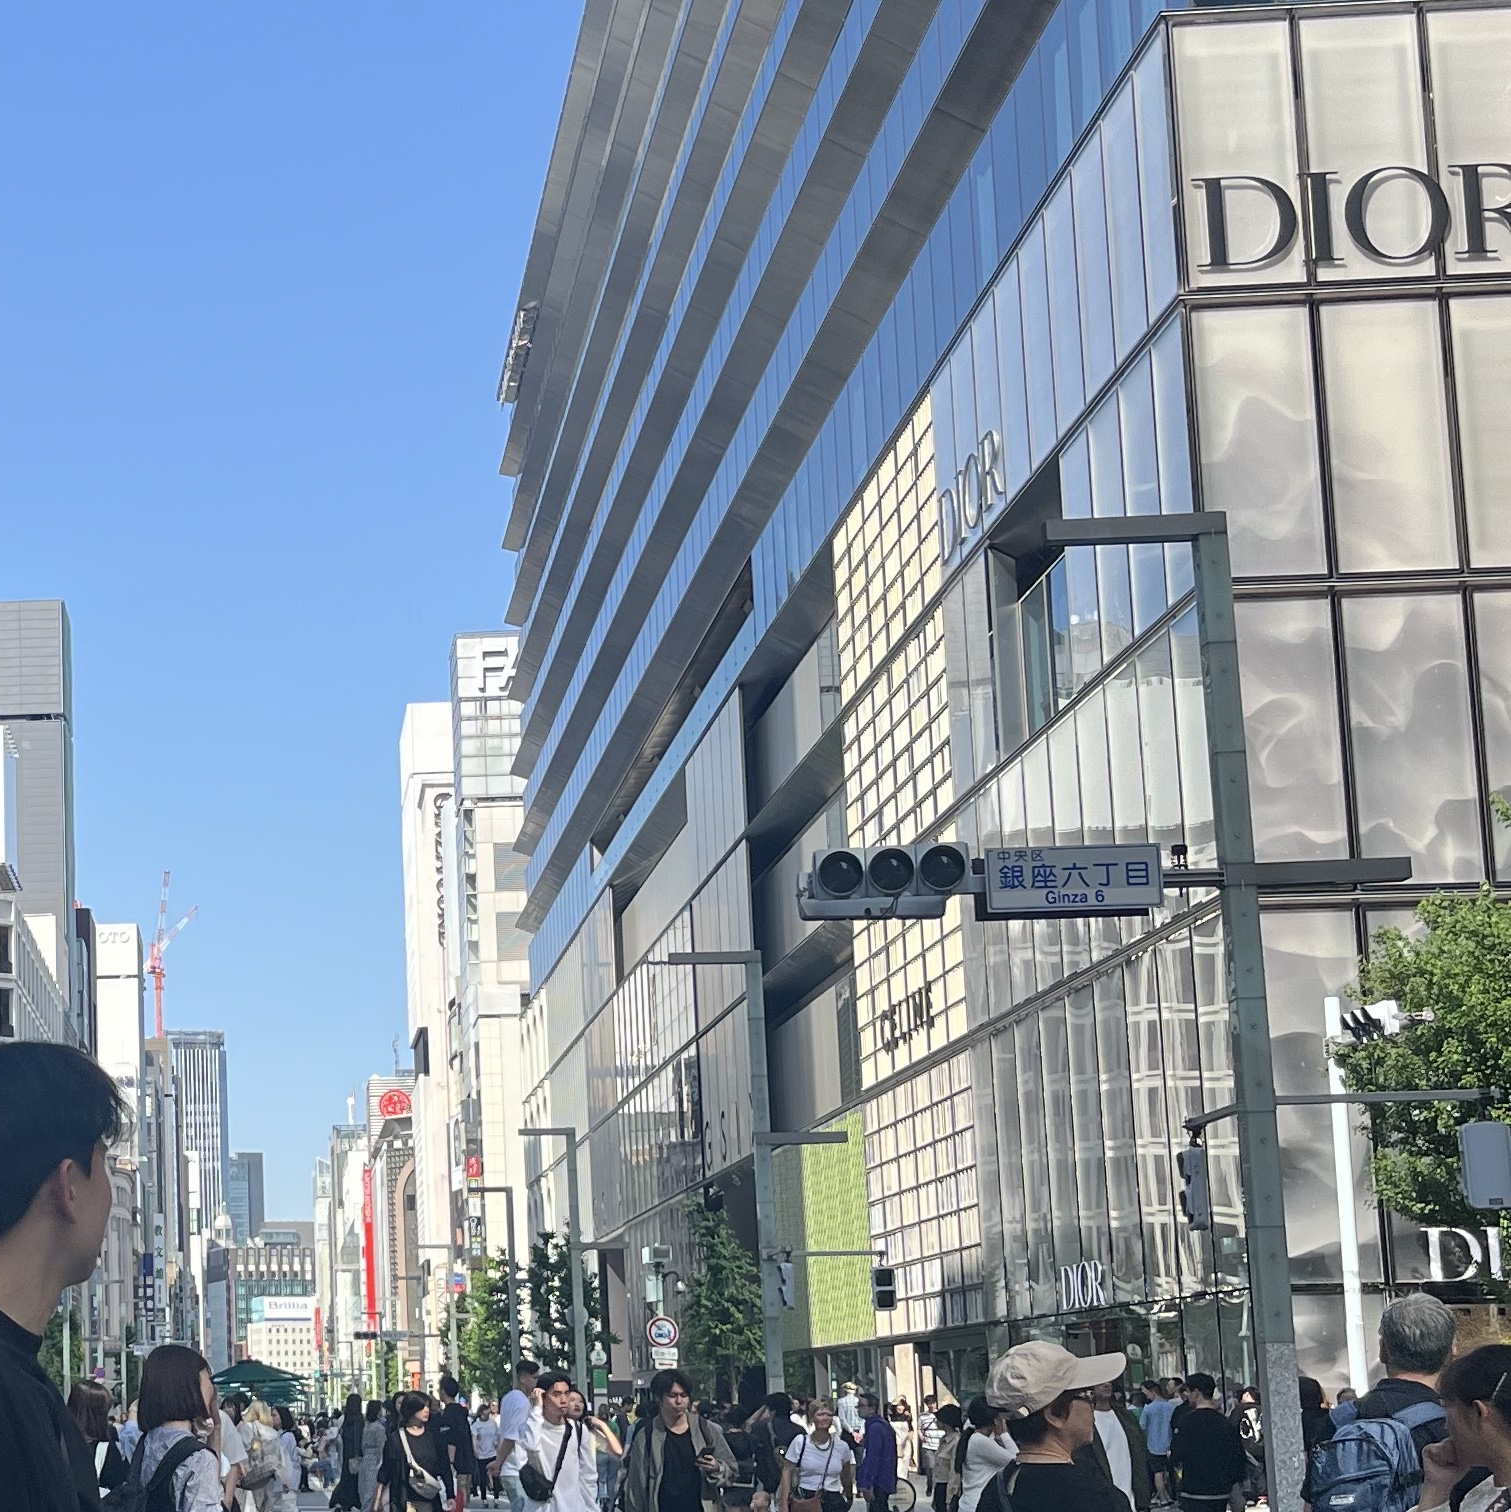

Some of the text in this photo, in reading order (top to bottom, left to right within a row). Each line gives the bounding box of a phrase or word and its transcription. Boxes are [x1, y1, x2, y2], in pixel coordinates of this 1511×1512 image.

[1191, 163, 1511, 273] DIOR
[938, 429, 1005, 567] DIOR
[996, 850, 1045, 864] 中央区
[998, 862, 1150, 890] 銀座六丁目
[1045, 889, 1105, 905] Ginza 6
[880, 981, 935, 1055] CELINE
[704, 1093, 754, 1171] GSI
[268, 1300, 308, 1310] Brillia
[1060, 1258, 1107, 1311] DIOR
